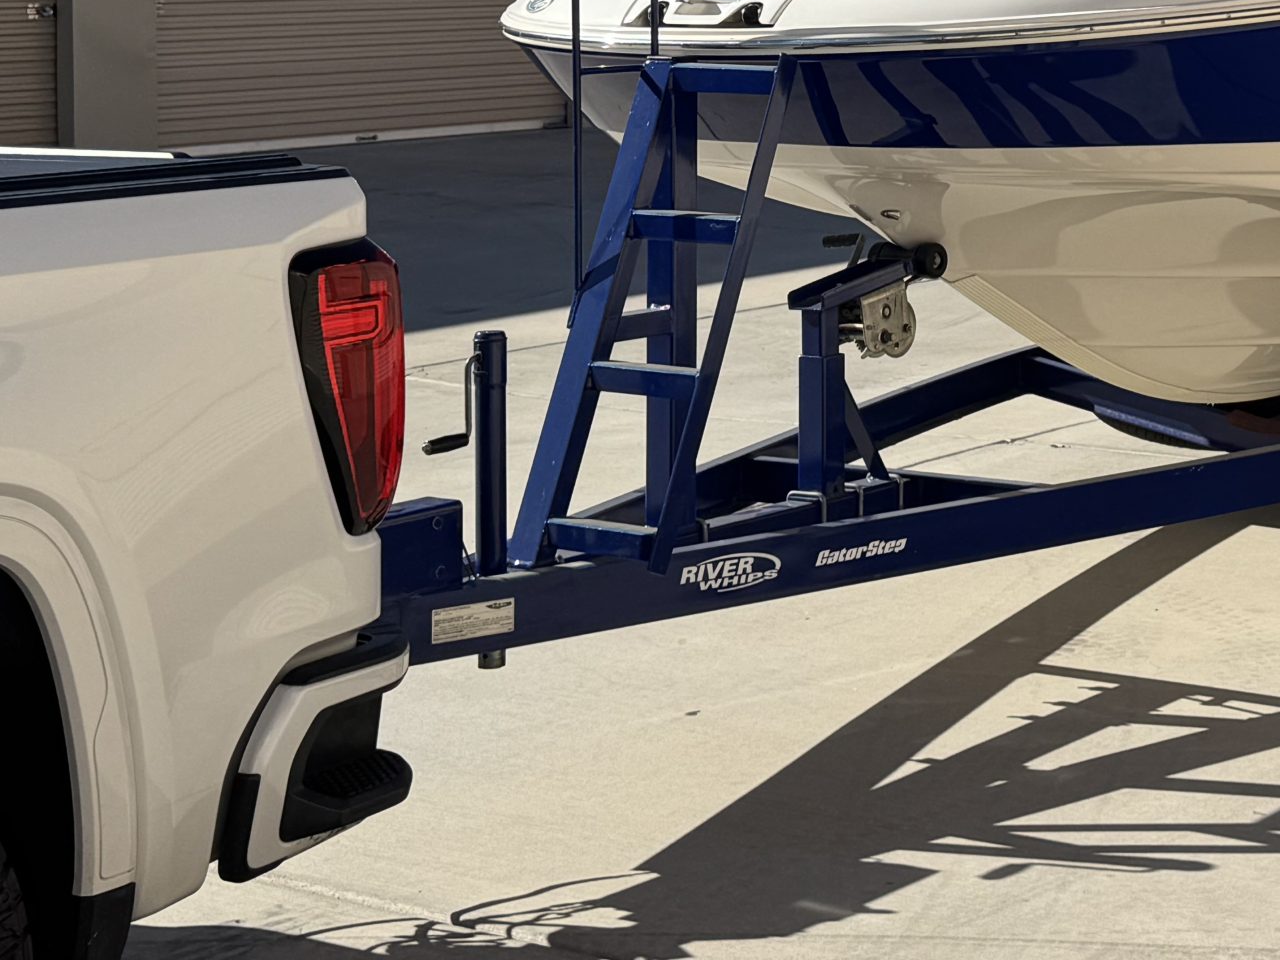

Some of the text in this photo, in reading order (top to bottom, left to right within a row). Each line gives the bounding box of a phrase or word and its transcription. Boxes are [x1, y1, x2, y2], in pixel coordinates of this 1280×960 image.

[815, 538, 908, 567] GatorStep
[680, 557, 754, 585] RIVER
[700, 569, 778, 592] WHIPS
